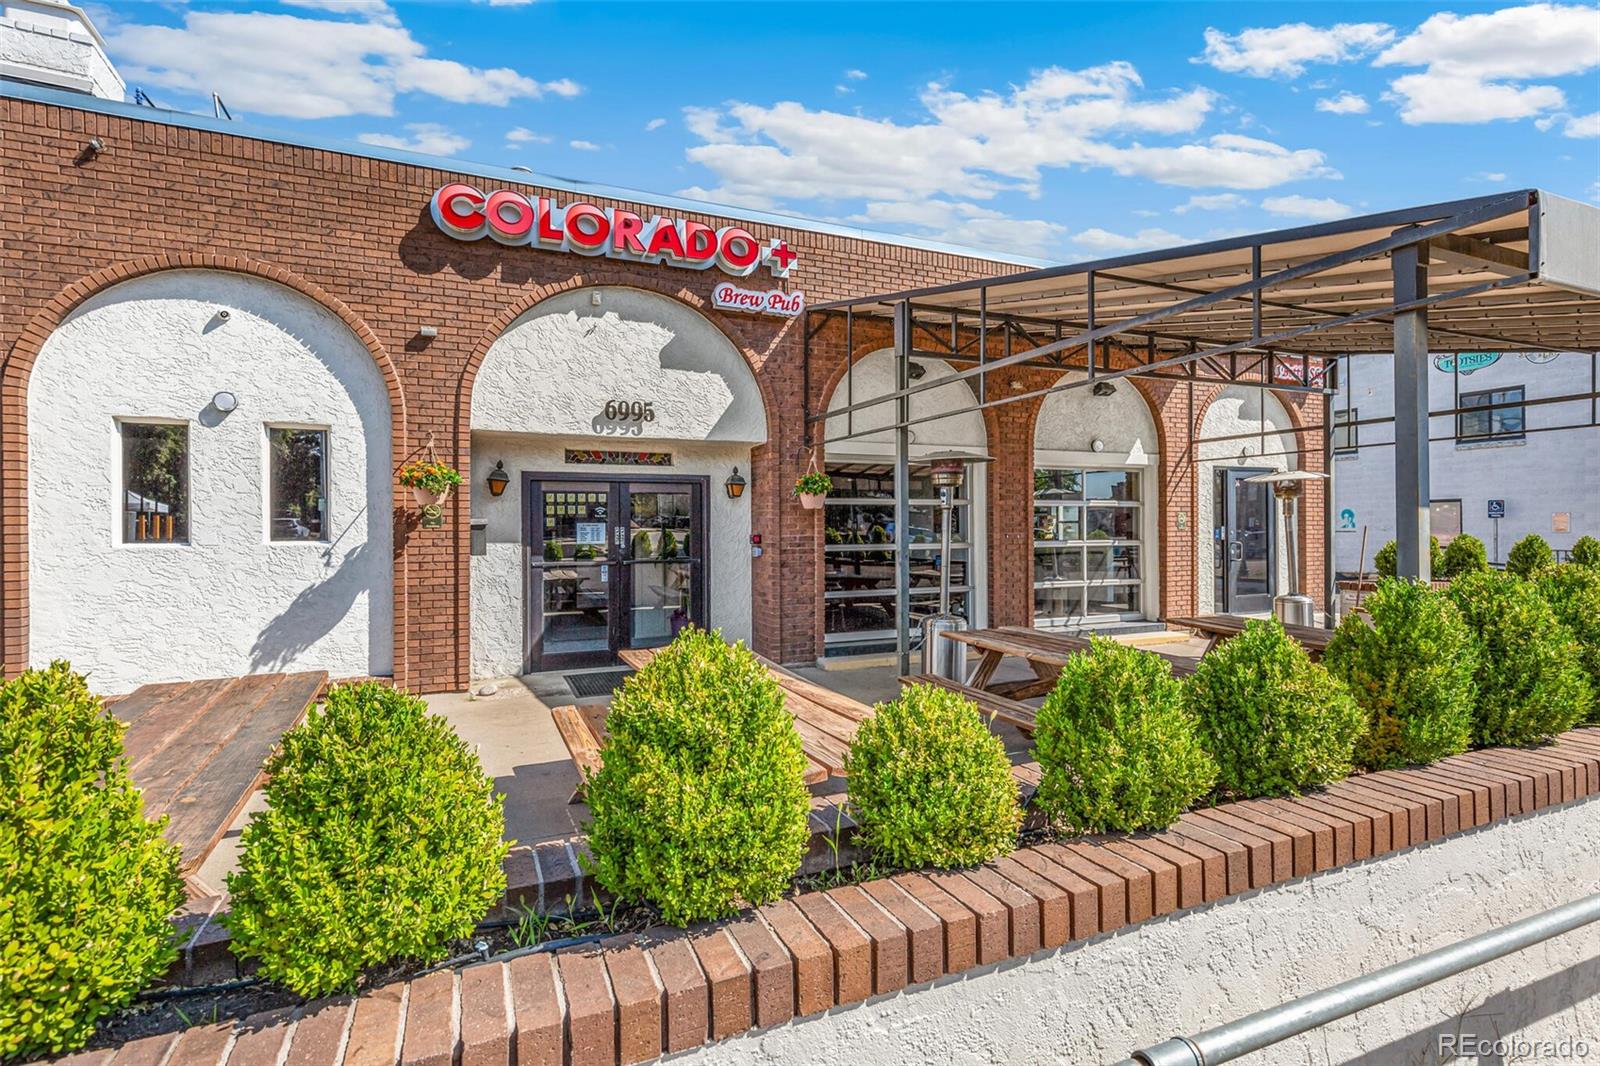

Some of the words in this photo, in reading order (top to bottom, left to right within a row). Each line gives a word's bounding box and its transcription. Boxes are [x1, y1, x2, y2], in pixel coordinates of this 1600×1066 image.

[718, 286, 765, 309] Brew
[767, 292, 802, 315] Pub
[604, 399, 655, 422] 6995
